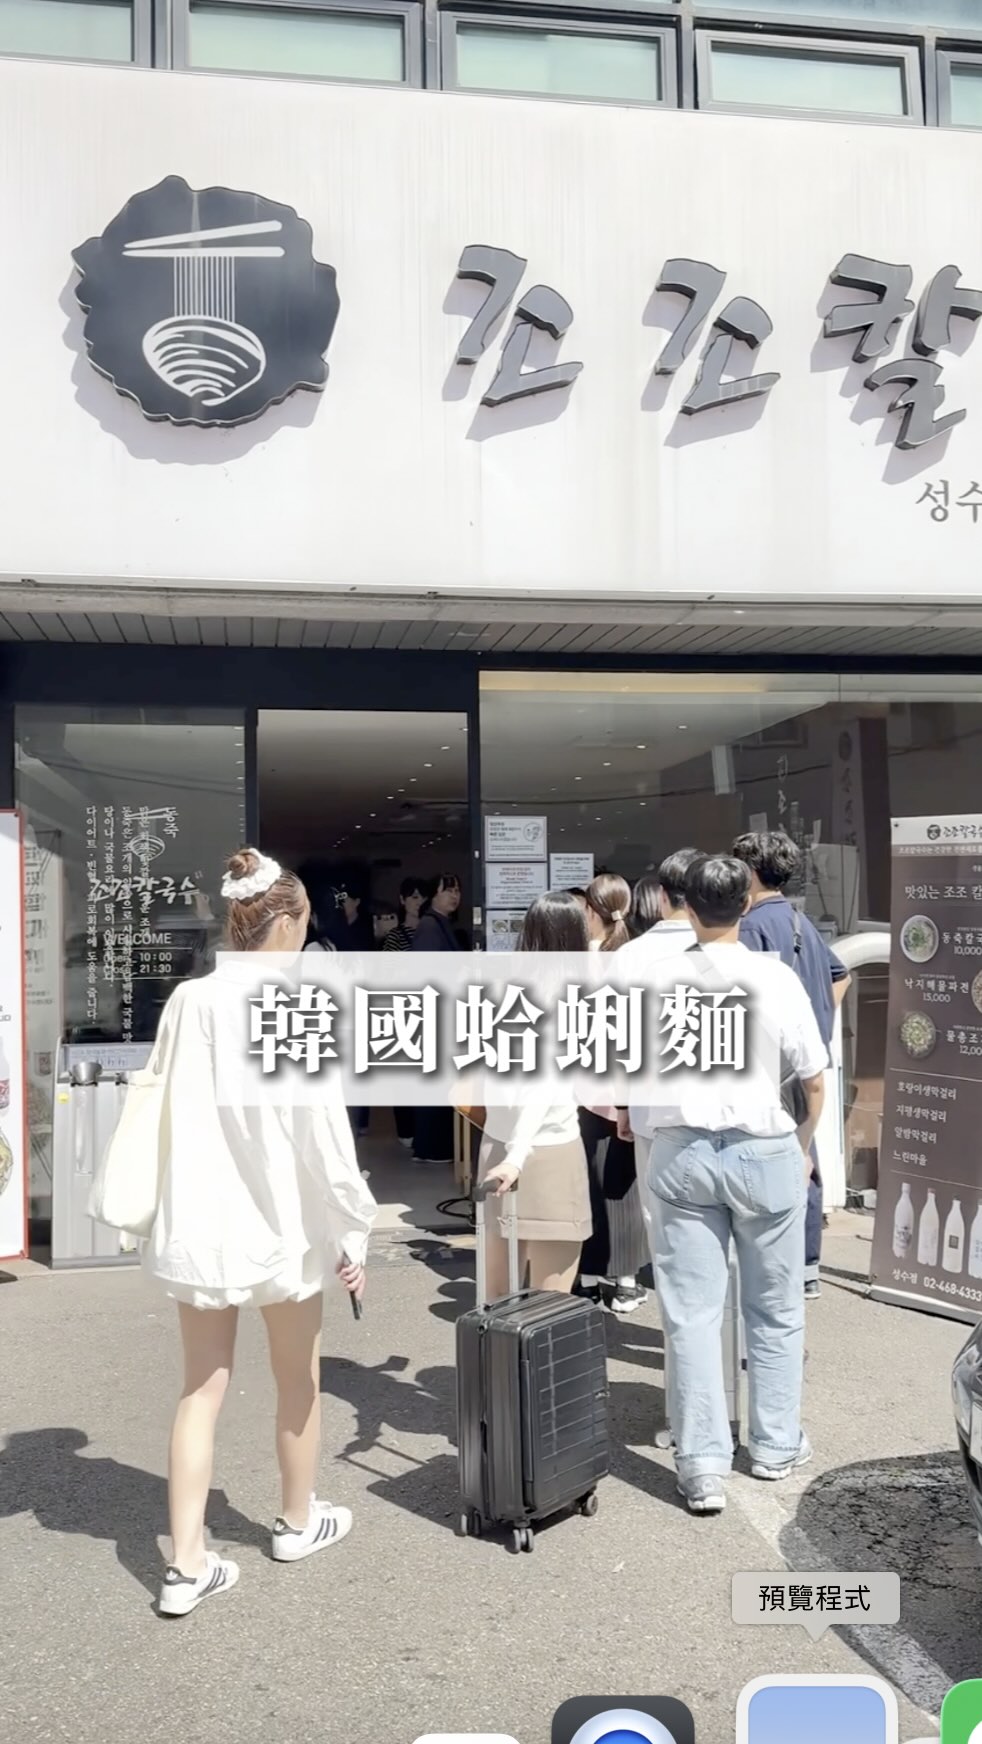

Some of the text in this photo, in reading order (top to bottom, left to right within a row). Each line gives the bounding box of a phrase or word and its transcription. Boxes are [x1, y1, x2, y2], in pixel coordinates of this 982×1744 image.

[916, 480, 982, 523] 성수
[904, 884, 940, 900] 맛있는
[943, 885, 967, 899] 조조
[103, 932, 172, 945] WELCOME
[922, 992, 952, 1003] 15,000
[946, 1029, 982, 1044] 물총조
[959, 1044, 982, 1056] 12,00
[896, 1080, 958, 1101] 호랑이생막걸리
[895, 1103, 948, 1123] 지평생막걸리
[893, 1125, 938, 1145] 알밤막걸리
[892, 1149, 928, 1167] 느린마을
[891, 1267, 919, 1284] 성수점
